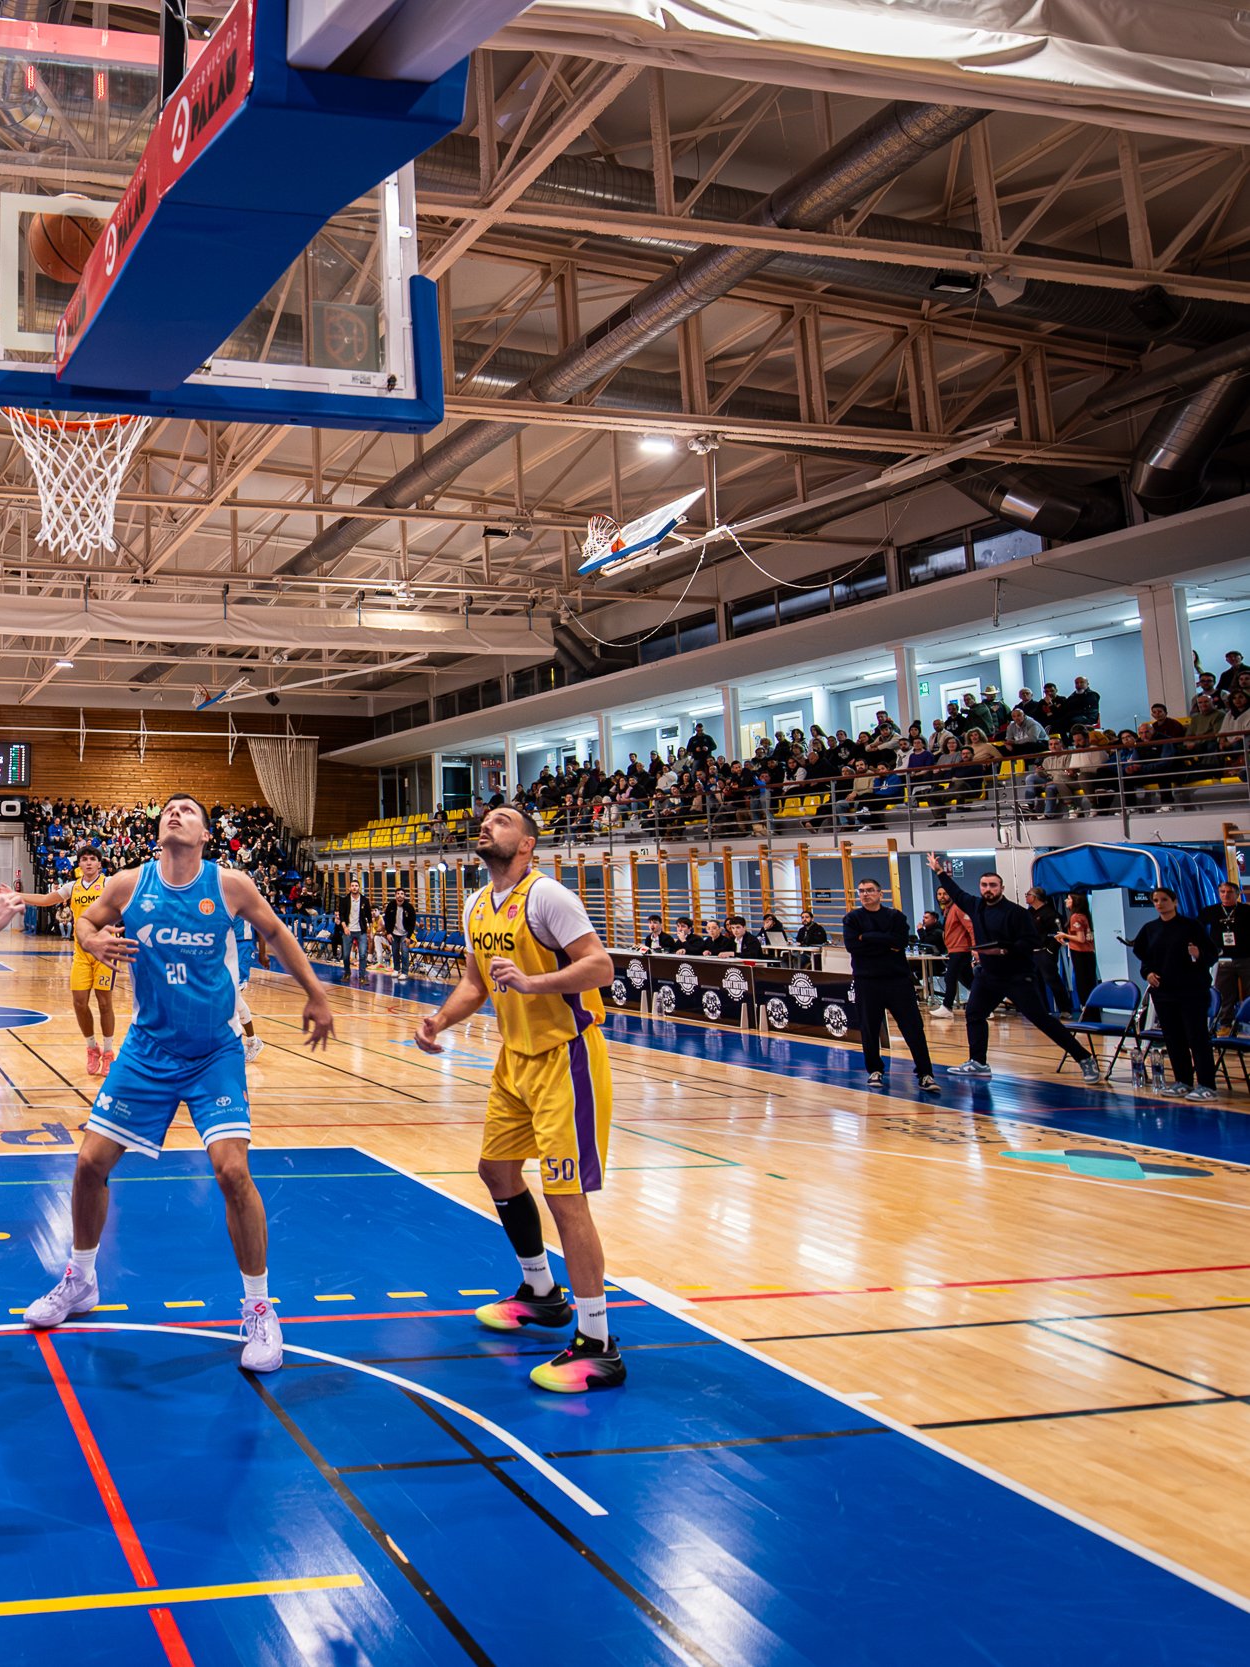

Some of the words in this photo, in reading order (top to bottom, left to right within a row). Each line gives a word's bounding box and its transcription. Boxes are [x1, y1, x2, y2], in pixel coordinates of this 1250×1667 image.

[191, 22, 239, 100] SERVICIOS
[190, 48, 239, 143] PALAU
[116, 160, 148, 224] SERVICIOS
[118, 180, 147, 257] PALAU
[156, 927, 215, 946] Class
[472, 932, 515, 951] HOMS
[99, 976, 110, 986] 22
[166, 963, 187, 984] 20
[546, 1157, 575, 1181] 50
